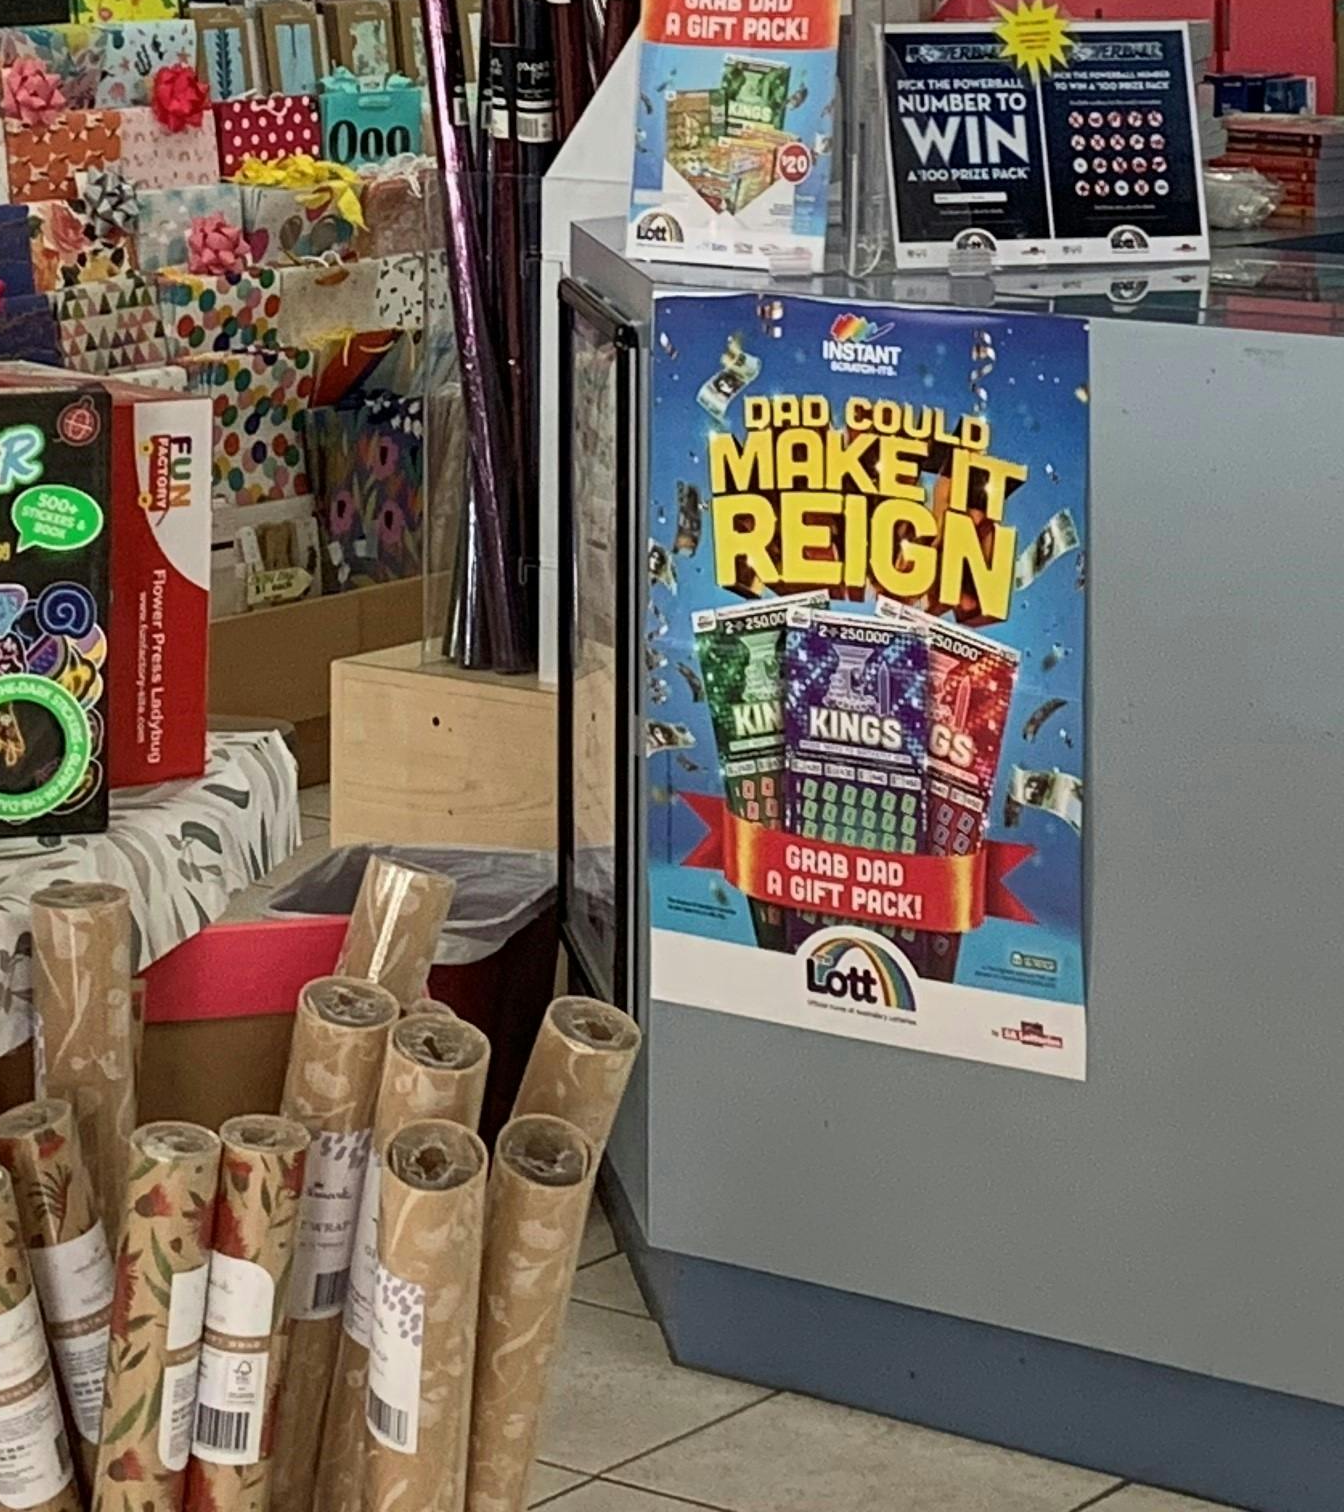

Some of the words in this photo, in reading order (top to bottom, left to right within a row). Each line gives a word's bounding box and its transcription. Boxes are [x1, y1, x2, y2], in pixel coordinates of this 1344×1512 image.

[665, 11, 681, 37] A
[686, 14, 738, 41] GIFT
[742, 16, 810, 43] PACK!
[896, 79, 927, 92] PICK
[927, 78, 952, 91] THE
[952, 77, 1025, 91] POWERBALL
[897, 92, 992, 114] NUMBER
[995, 91, 1028, 112] TO
[900, 114, 1031, 167] WIN
[781, 155, 808, 176] $20
[636, 225, 668, 241] Lott
[822, 339, 903, 366] INSTANT
[743, 394, 831, 431] DAD
[844, 397, 991, 452] COULD
[156, 436, 169, 510] FACTORY
[169, 434, 193, 508] FUN
[707, 426, 930, 503] MAKE
[949, 448, 1029, 522] IT
[36, 491, 80, 516] 500+
[32, 521, 68, 540] BOOK
[711, 491, 1017, 622] REIGN
[153, 568, 168, 630] Flower
[149, 632, 166, 684] Press
[146, 686, 166, 765] Ladybug
[808, 706, 904, 751] KINGS
[931, 723, 975, 768] GS
[784, 845, 850, 879] GRAB
[855, 853, 905, 887] DAD
[766, 871, 783, 896] A
[789, 875, 845, 909] GIFT
[851, 886, 923, 921] PACK!
[806, 956, 878, 1005] Lott
